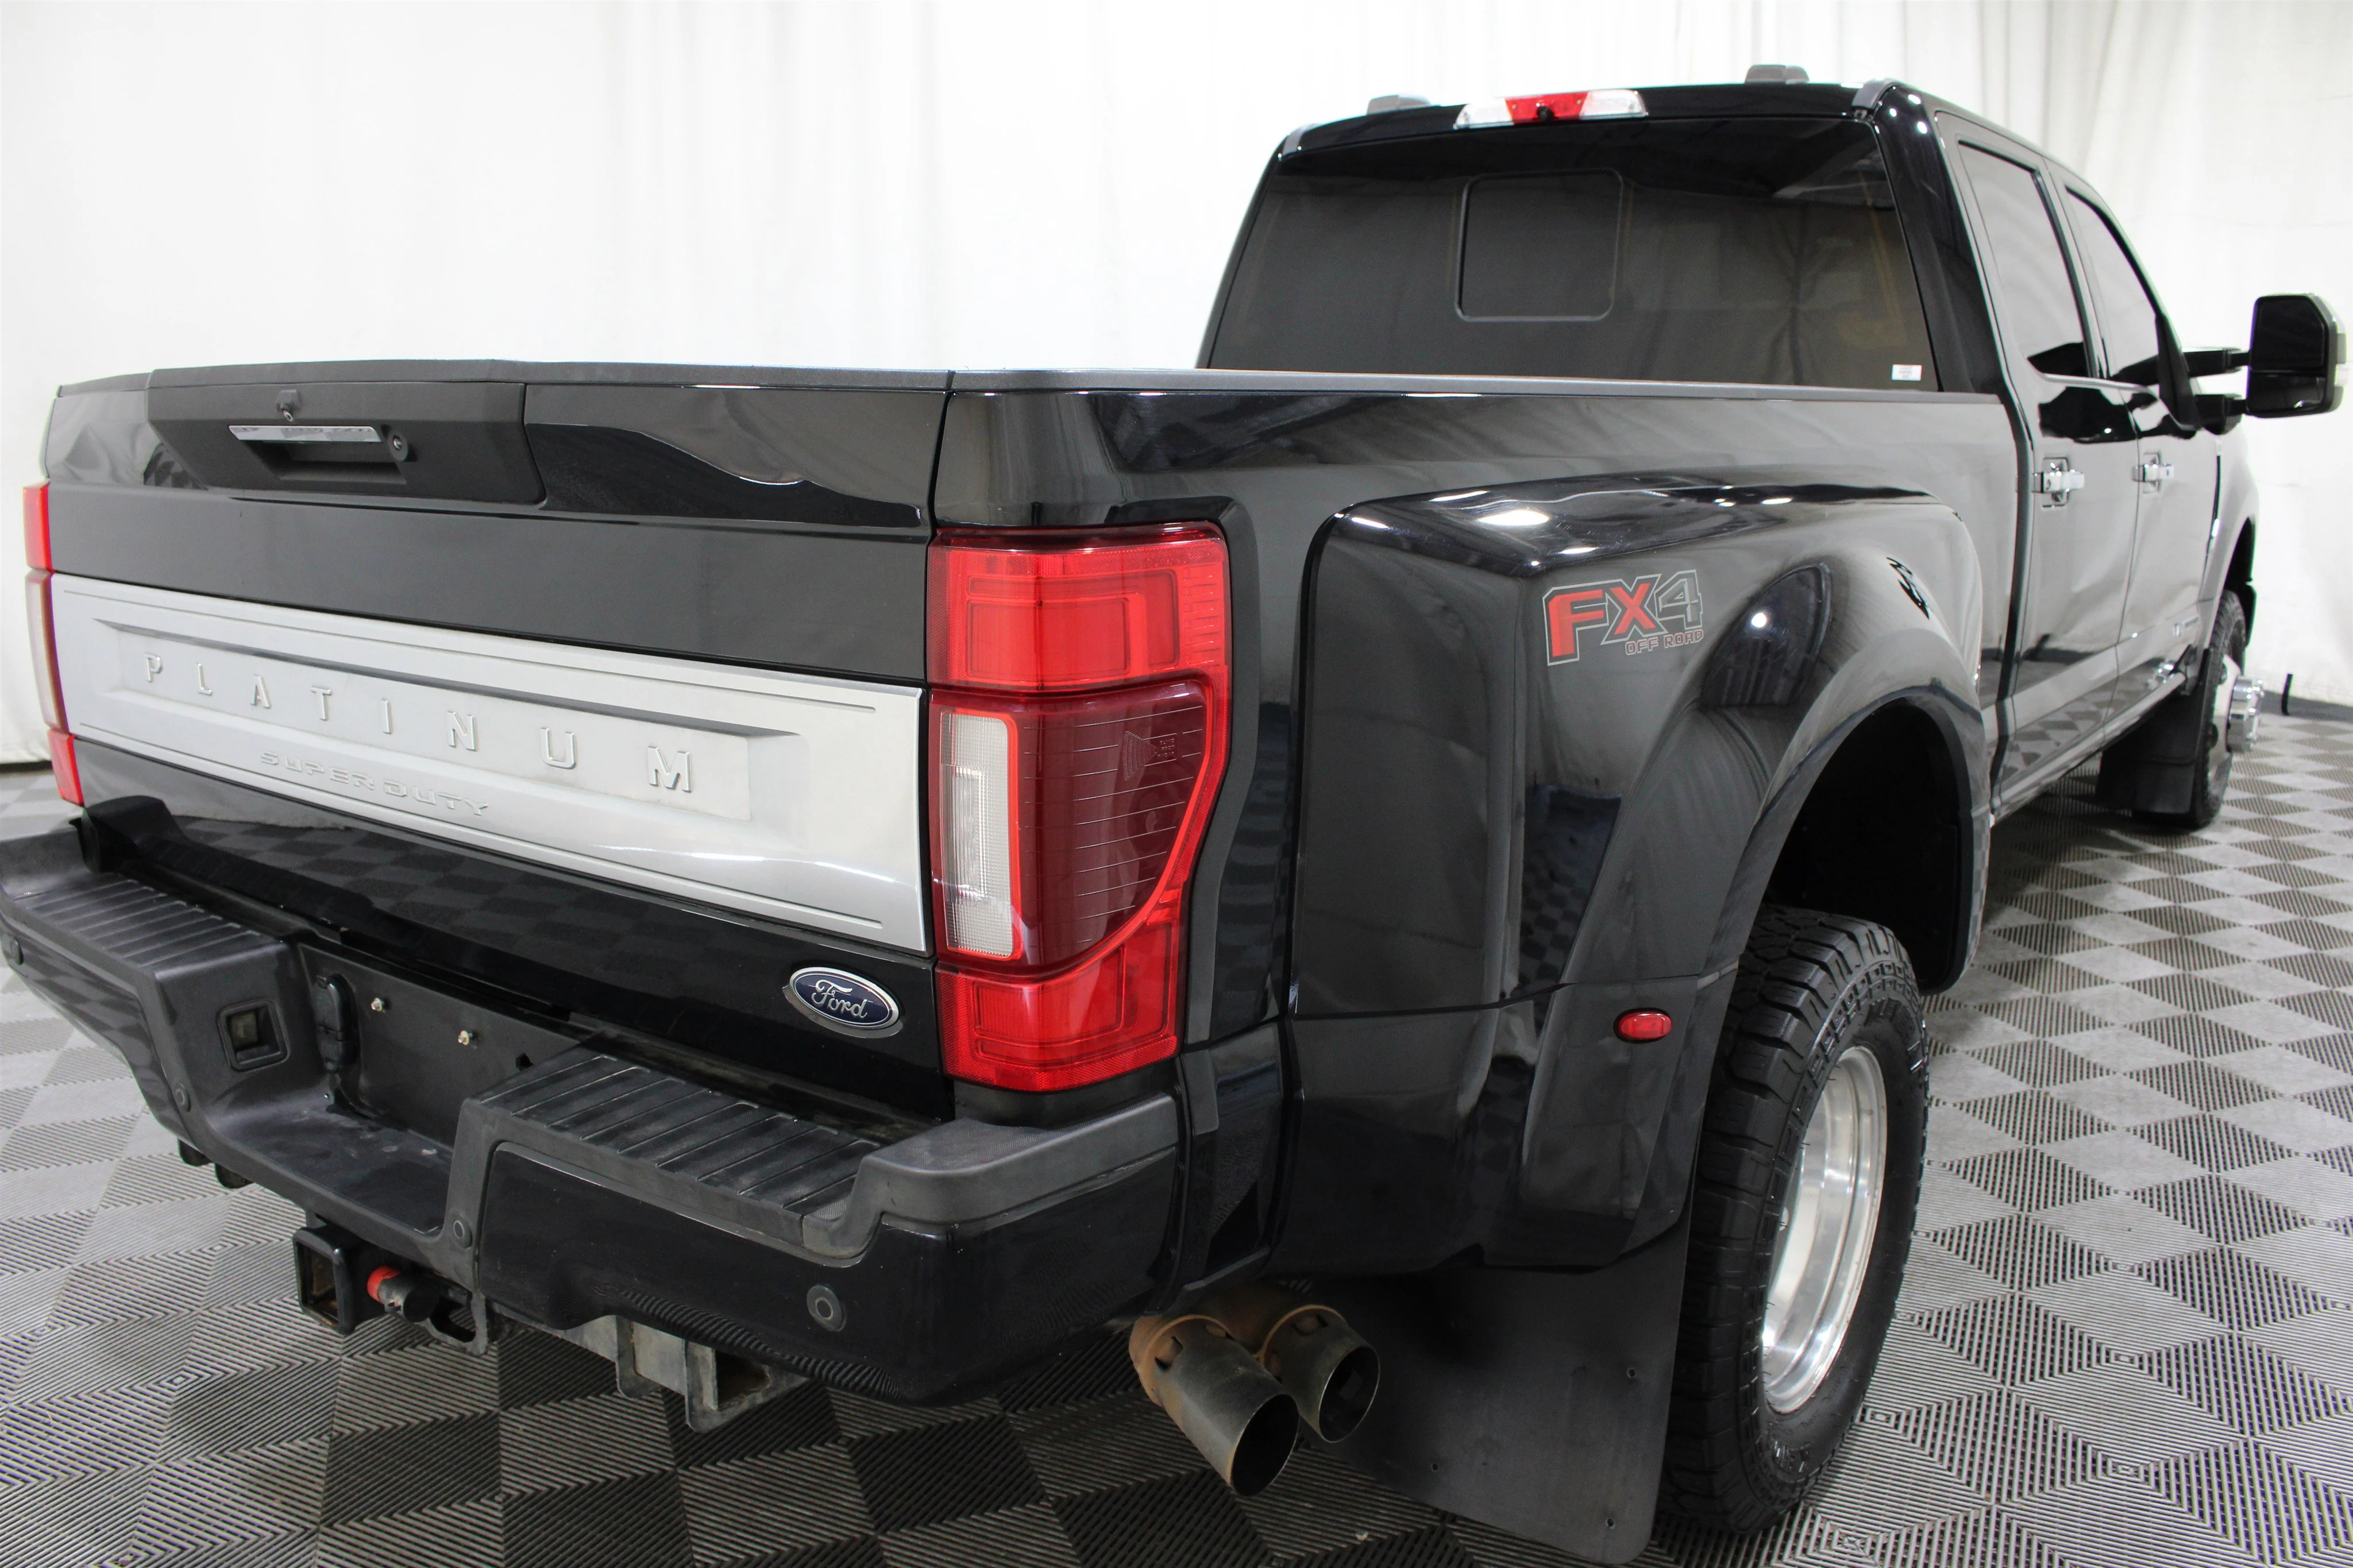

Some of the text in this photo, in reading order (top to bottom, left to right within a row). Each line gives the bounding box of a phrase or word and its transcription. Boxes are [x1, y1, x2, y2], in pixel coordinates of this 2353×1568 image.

[1542, 569, 1703, 666] FX4
[1625, 629, 1704, 655] OFF ROAD
[145, 654, 692, 793] PLATINUM
[261, 751, 489, 816] SUPER DUTY
[811, 979, 868, 1019] Ford
